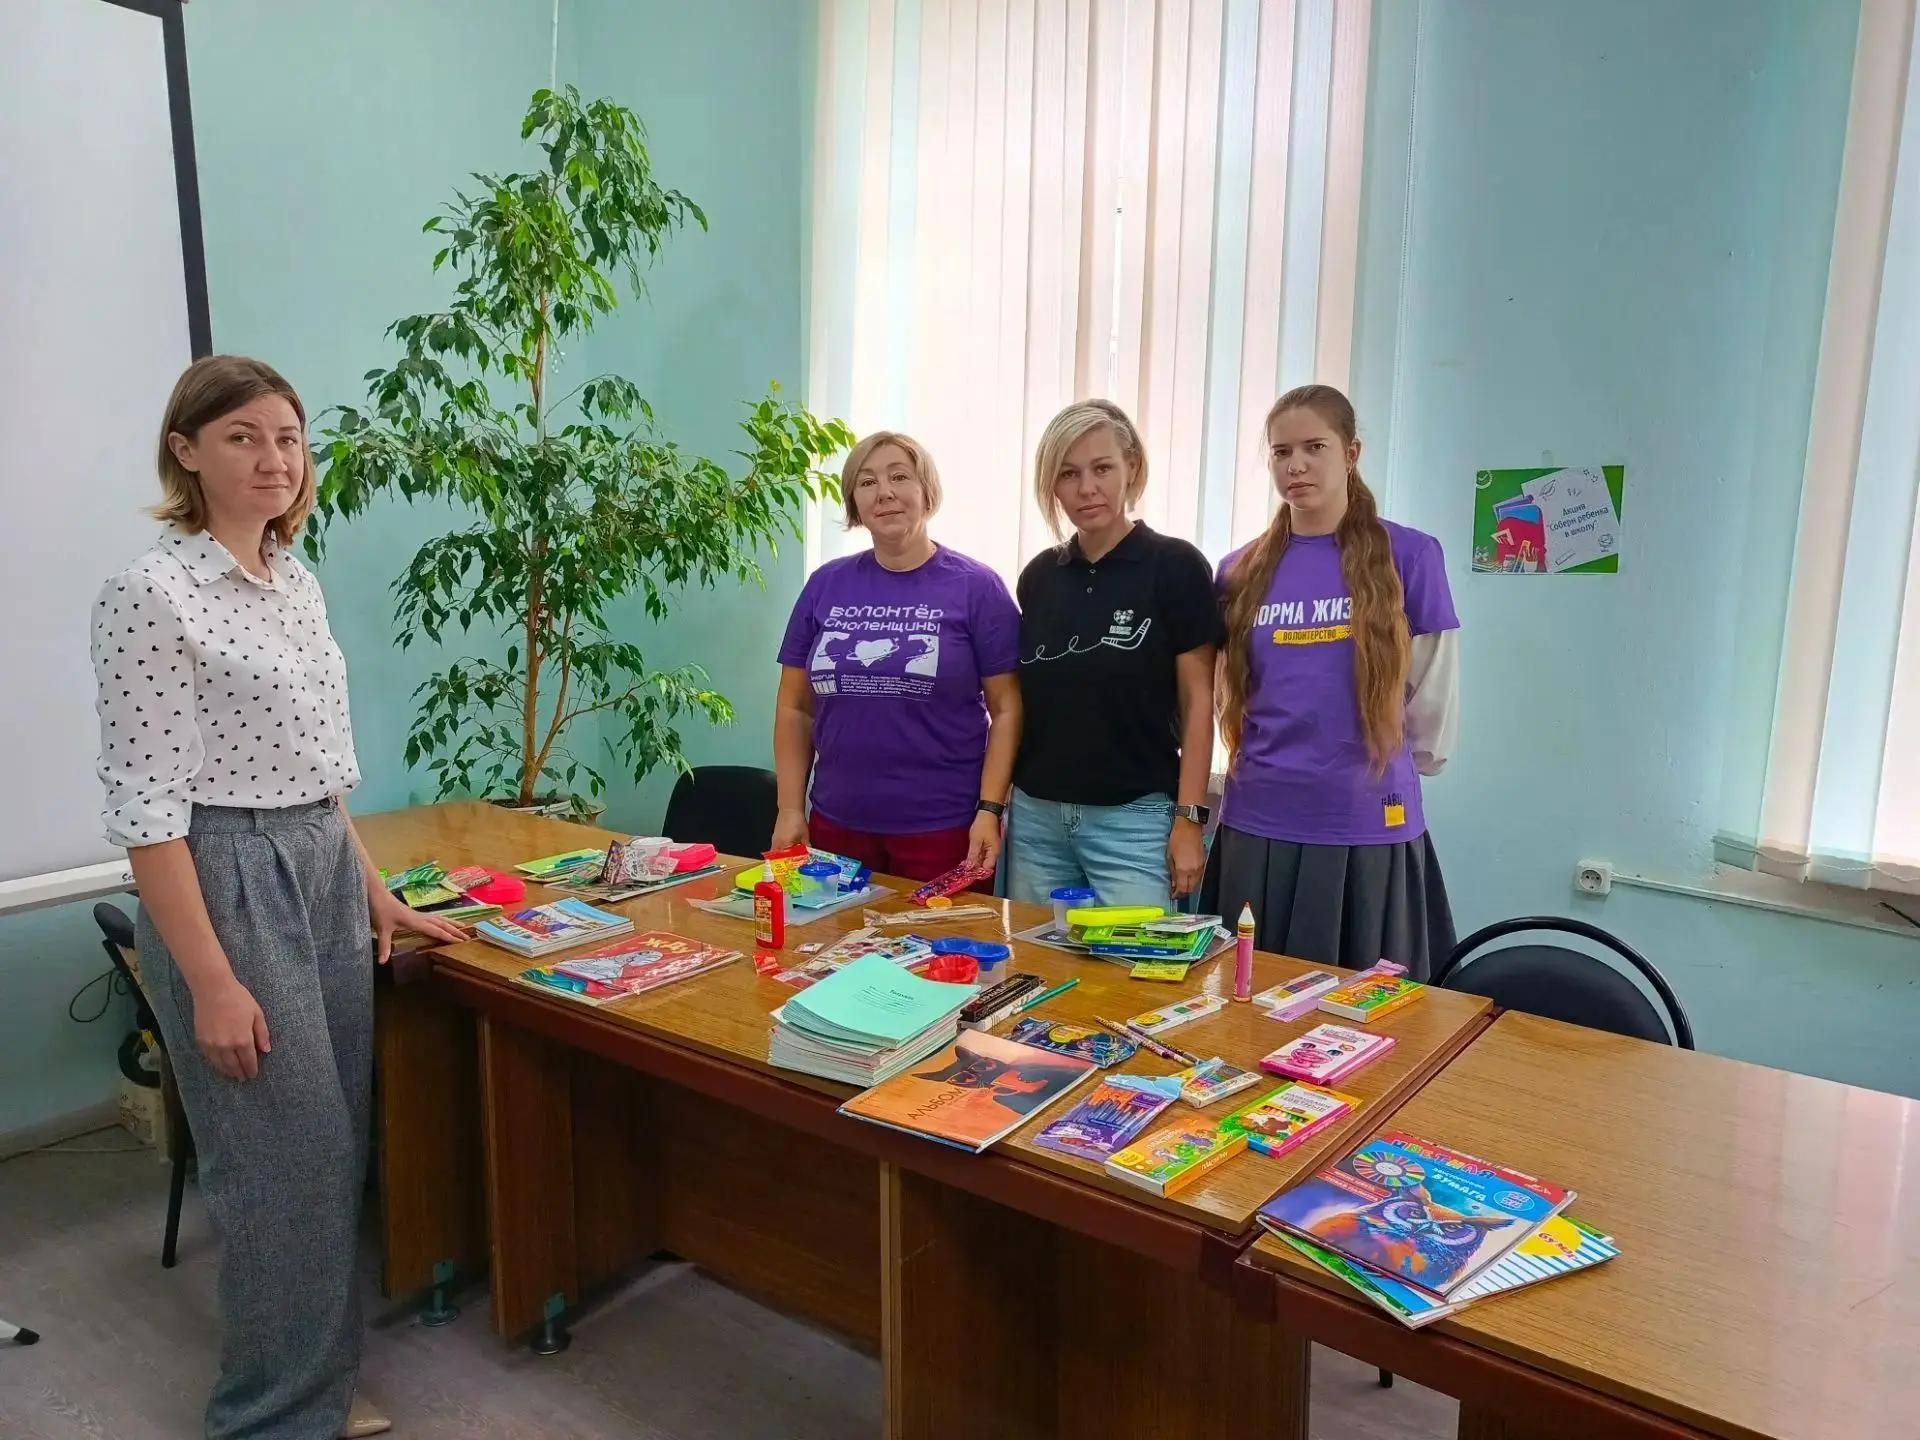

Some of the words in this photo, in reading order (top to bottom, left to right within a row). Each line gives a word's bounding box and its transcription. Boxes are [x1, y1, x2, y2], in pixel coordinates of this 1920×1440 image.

[1562, 503, 1586, 516] Акция
[1577, 506, 1609, 524] ребенка
[1311, 597, 1353, 623] ЖИЗ
[1282, 628, 1337, 641] ВОЛОНТЕРСТВО
[906, 1087, 968, 1120] АЛЬБОМ
